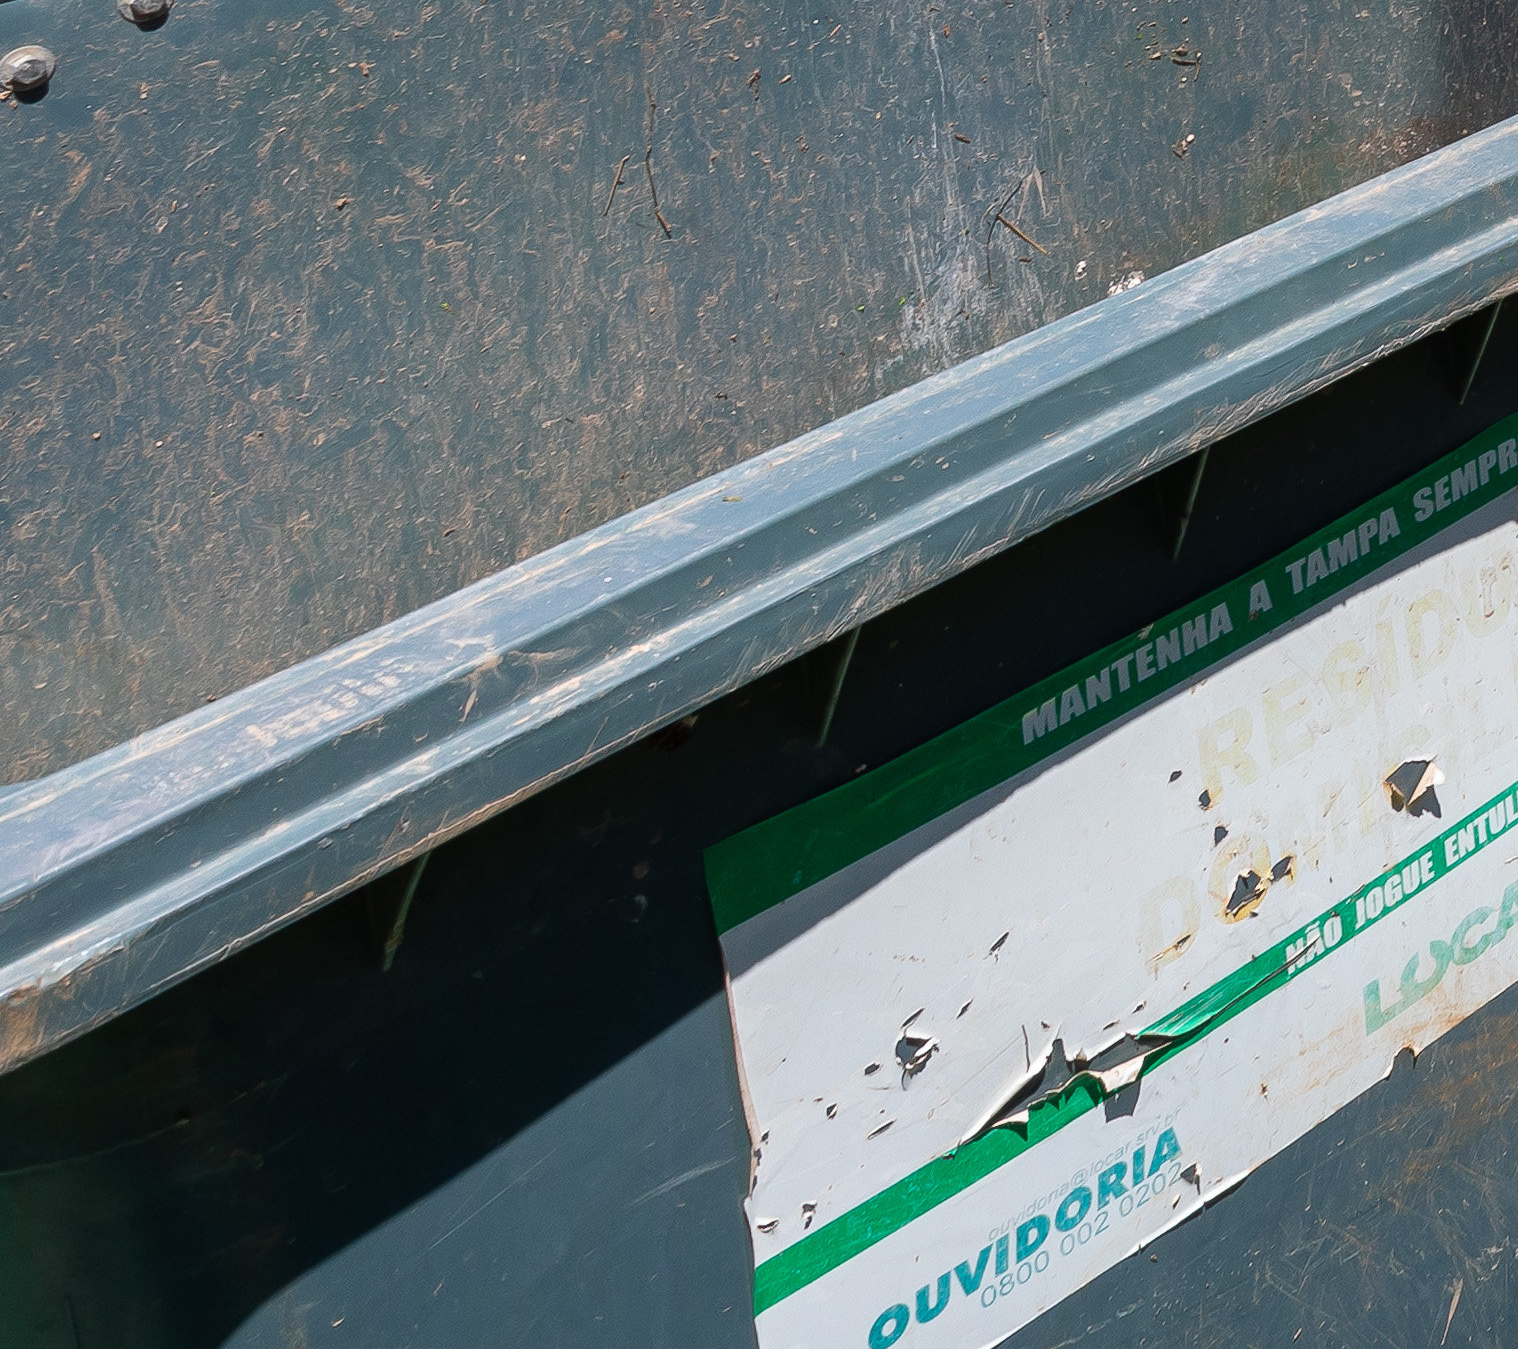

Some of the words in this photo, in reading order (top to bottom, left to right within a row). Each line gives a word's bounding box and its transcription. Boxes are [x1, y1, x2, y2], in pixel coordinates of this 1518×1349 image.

[1021, 602, 1234, 746] MANTENHA
[1248, 579, 1273, 621] A
[1286, 507, 1401, 595] TAMPA
[1284, 913, 1343, 977] NÃO
[1353, 850, 1436, 930] JOGUE
[867, 1126, 1183, 1349] OUVIDORIA
[980, 1250, 1050, 1309] 0800
[1060, 1210, 1110, 1256] 002
[1119, 1161, 1183, 1218] 0202
